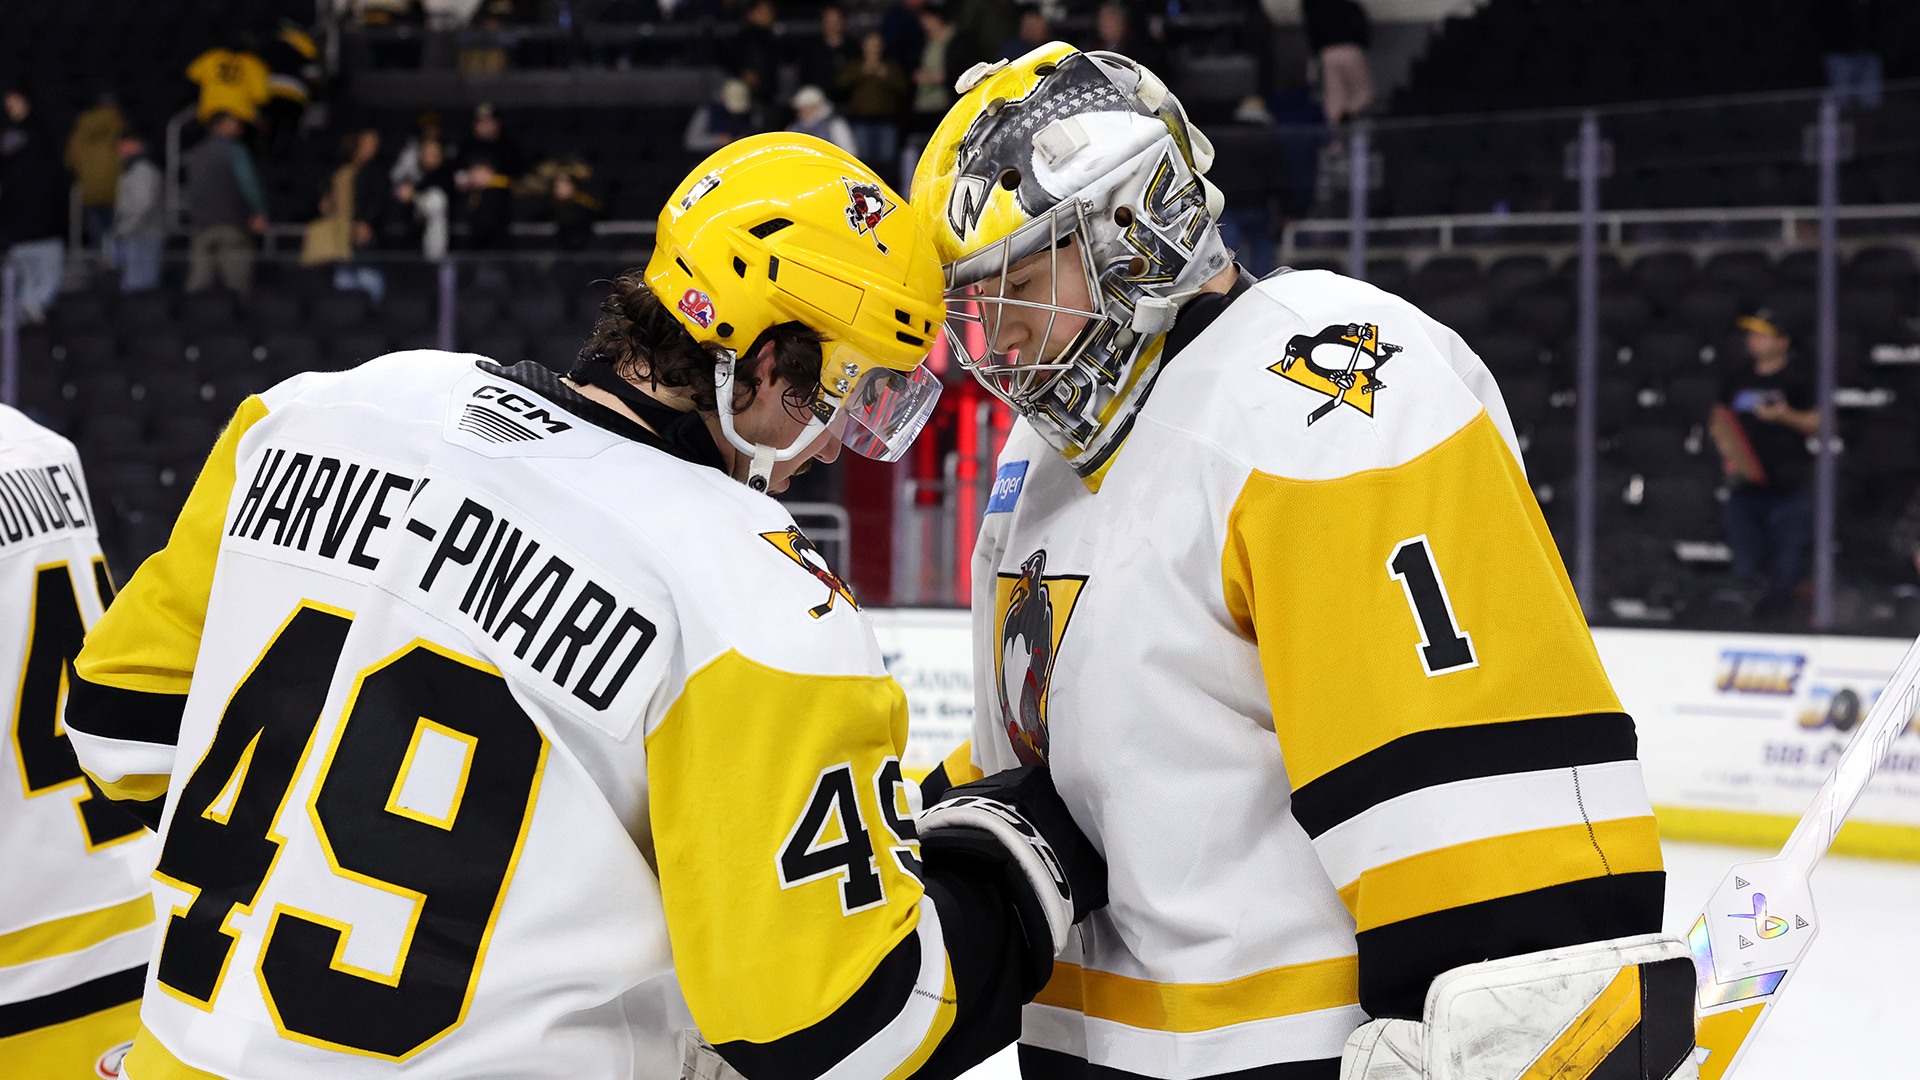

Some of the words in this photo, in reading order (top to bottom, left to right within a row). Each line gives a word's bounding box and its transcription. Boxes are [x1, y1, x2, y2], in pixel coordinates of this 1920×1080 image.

[472, 384, 573, 434] CCM
[1385, 533, 1480, 678] 1
[151, 598, 550, 1063] 49
